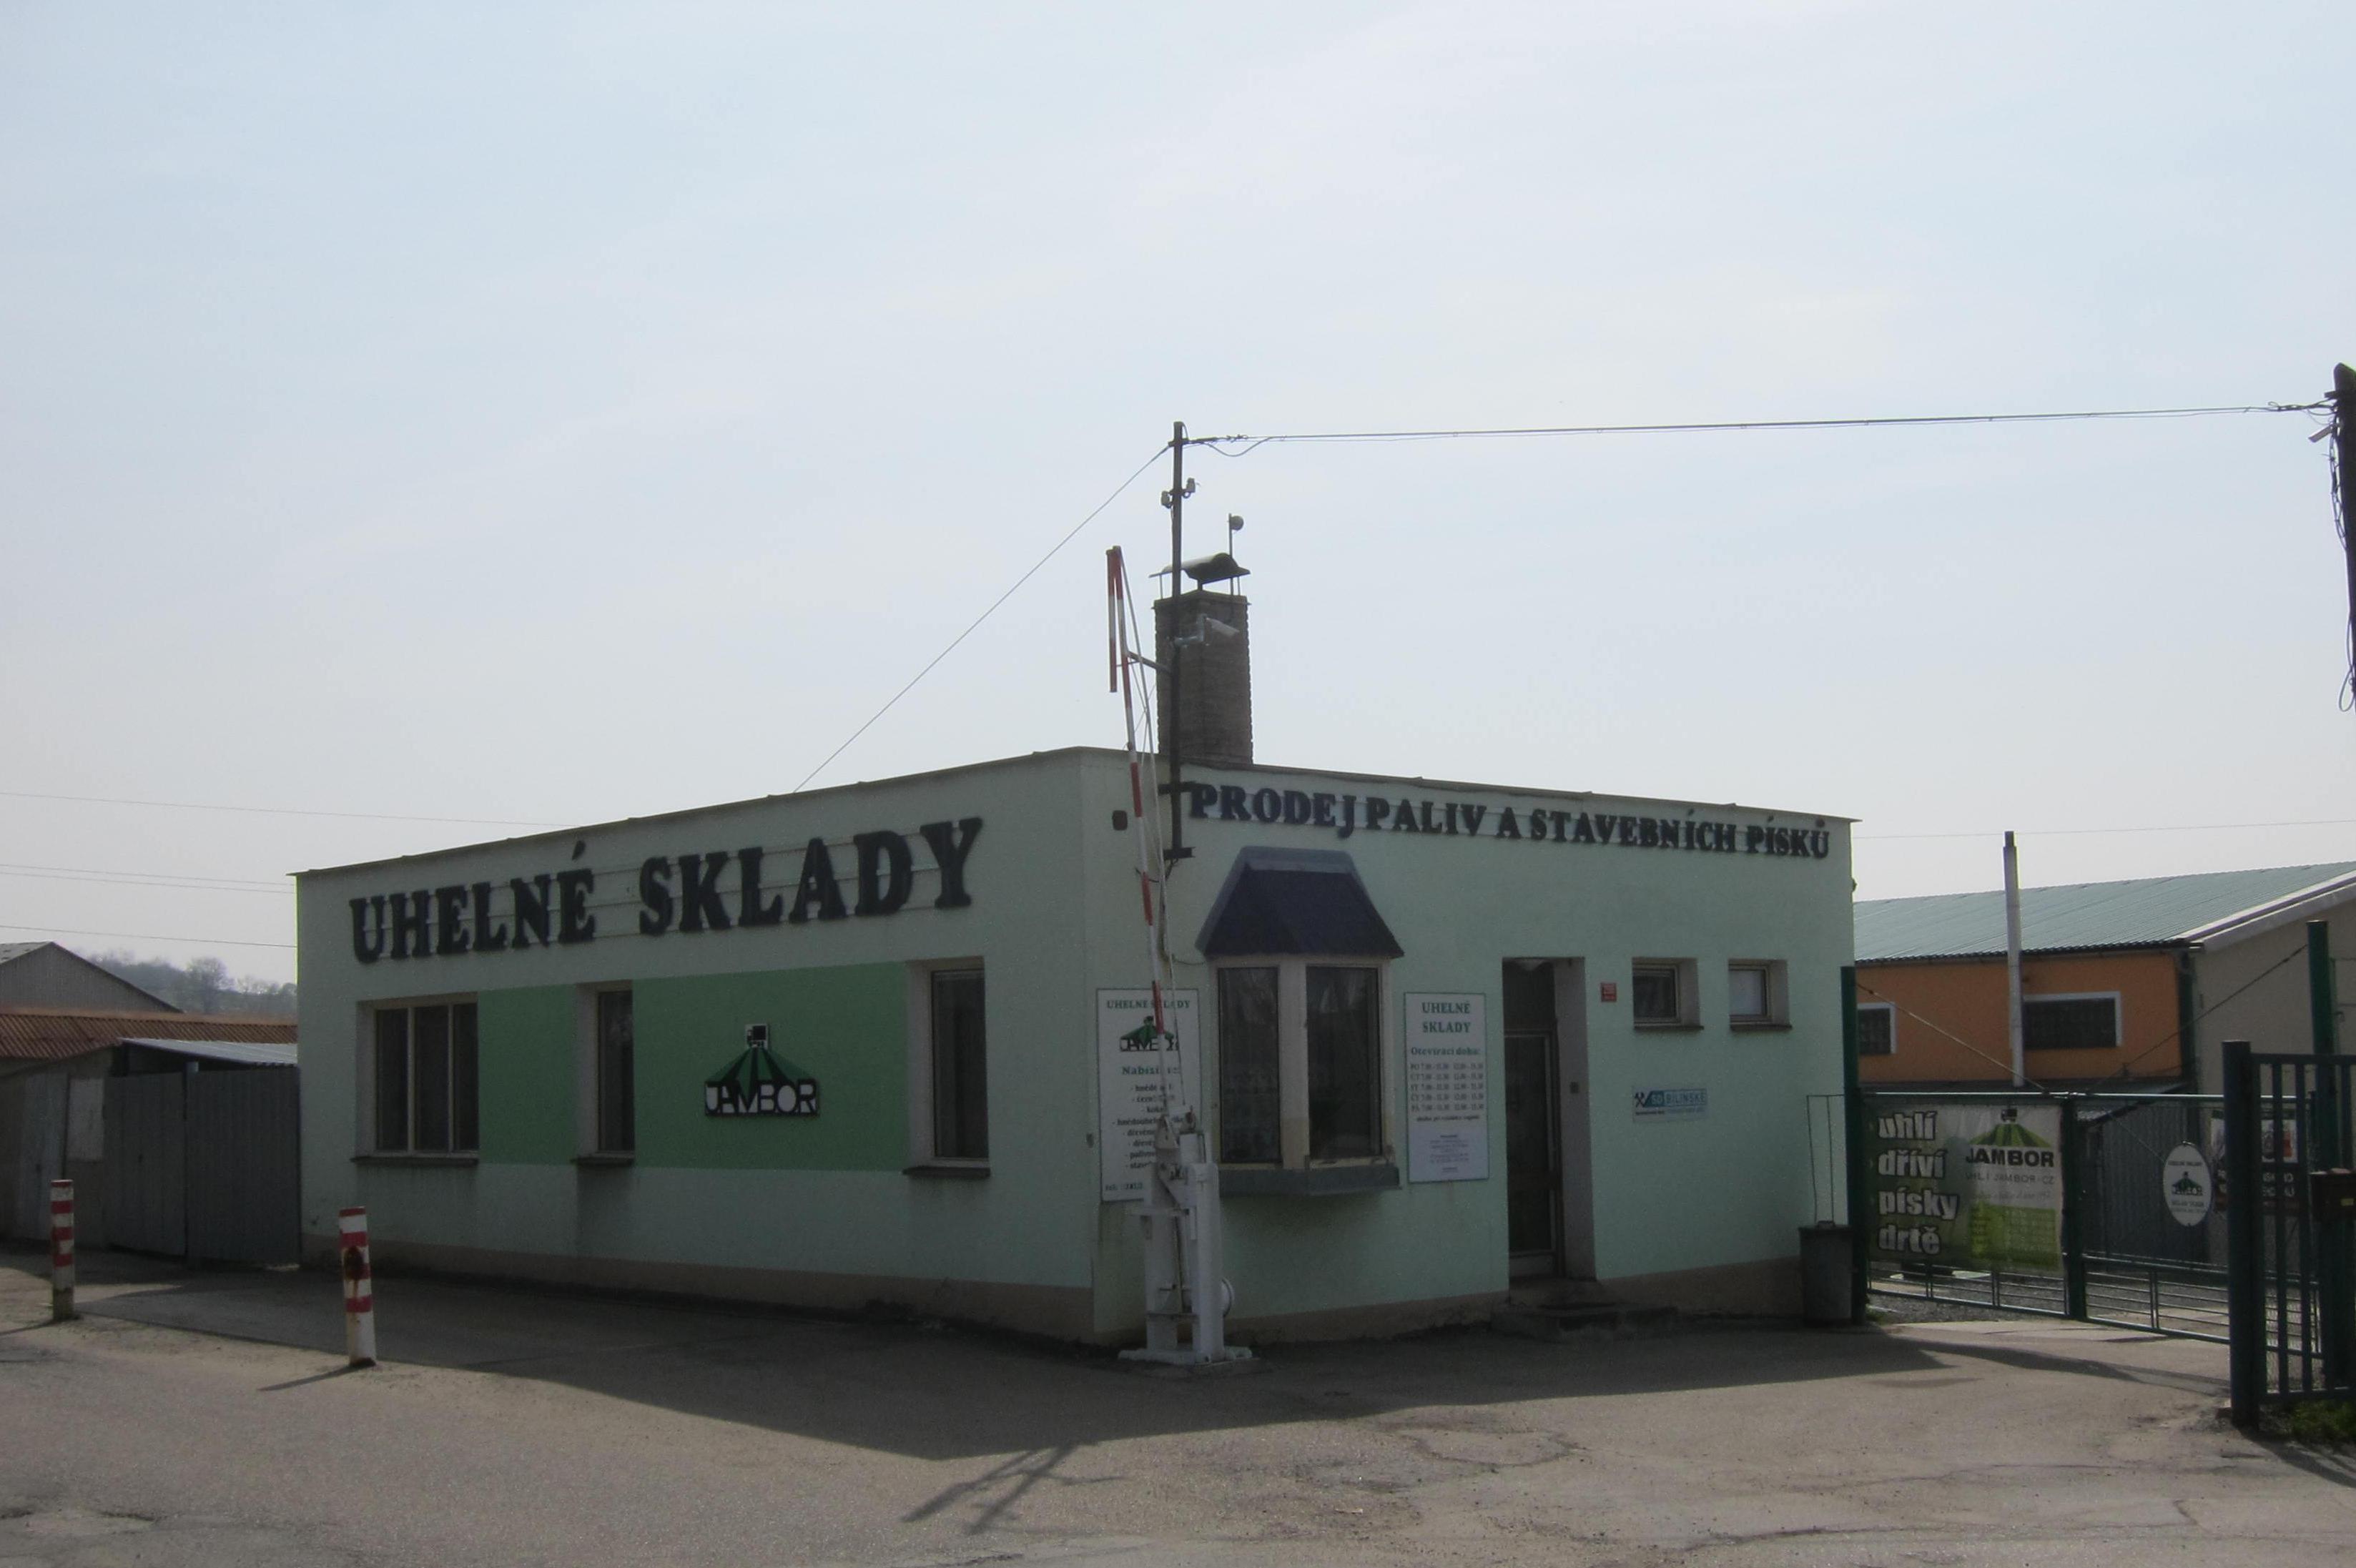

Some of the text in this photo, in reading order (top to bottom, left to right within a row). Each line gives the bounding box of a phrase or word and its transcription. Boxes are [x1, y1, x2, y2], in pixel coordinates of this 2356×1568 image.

[1189, 784, 1830, 859] PRODEJ PALIV A STAVEBNÍCH PÍSKŮ
[349, 817, 983, 965] UHELNÉ SKLADY
[1421, 1000, 1471, 1015] UHELNÉ
[1421, 1021, 1472, 1033] SKLADY
[704, 1078, 819, 1116] JAMBOR
[1878, 1110, 1937, 1140] uhlí
[1878, 1148, 1948, 1179] dříví
[1966, 1148, 2054, 1168] JAMBOR
[1878, 1186, 1960, 1221] písky
[1878, 1223, 1941, 1256] drtě
